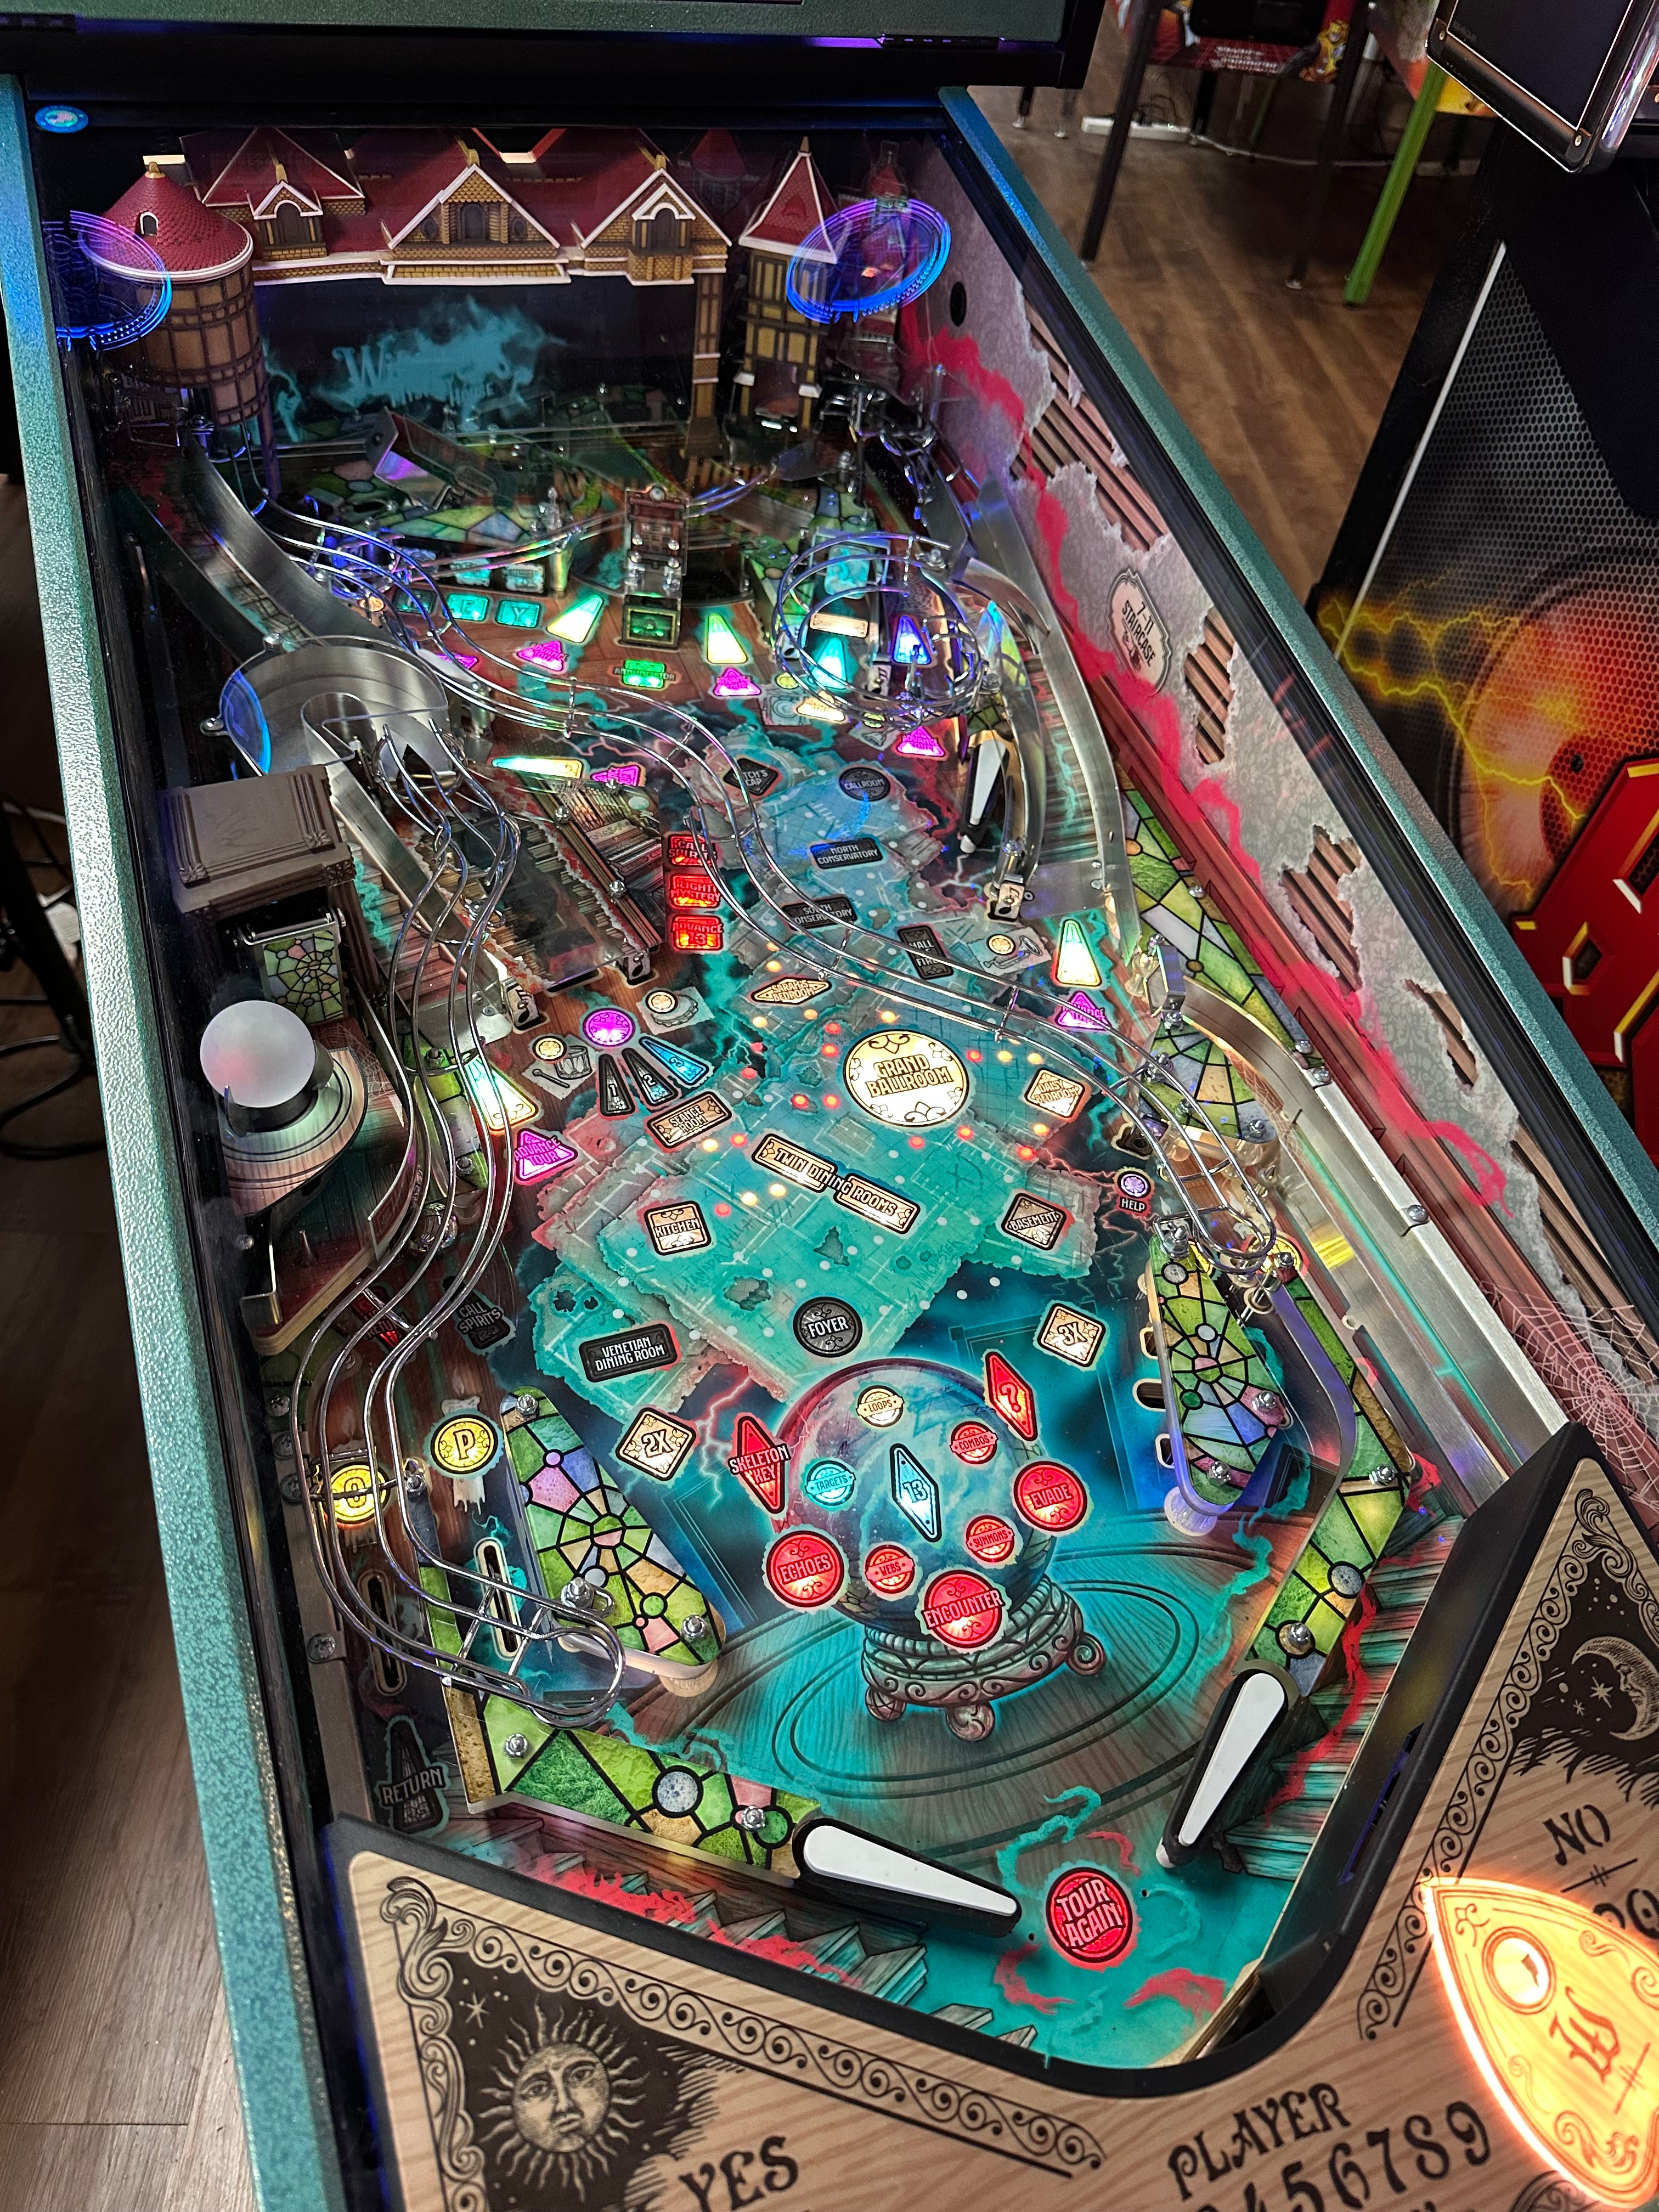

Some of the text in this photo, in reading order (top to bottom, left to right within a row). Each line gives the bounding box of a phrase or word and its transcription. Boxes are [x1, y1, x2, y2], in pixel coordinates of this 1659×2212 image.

[512, 607, 528, 619] Y
[1122, 600, 1155, 667] STAIRCASE
[531, 643, 568, 661] ADVANCE
[614, 667, 675, 680] ANNUNCIATOR
[902, 734, 938, 747] ADVANCE
[745, 778, 763, 787] CAP
[844, 778, 884, 791] CALLROOM
[817, 848, 878, 865] CONSERVATORY
[830, 844, 859, 854] NORTH
[671, 889, 721, 902] MYSTERY
[672, 922, 724, 933] ADVANCE
[771, 979, 809, 992] SARAH'S
[773, 988, 816, 1003] BEDROOM
[670, 1057, 684, 1068] 3
[873, 1054, 930, 1077] GRAND
[609, 1084, 618, 1097] 1
[643, 1074, 656, 1087] 2
[865, 1066, 954, 1098] BALLROOM
[1039, 1080, 1064, 1093] DAISY
[1035, 1087, 1080, 1104] BEDROOM
[669, 1104, 704, 1128] SEANCE
[680, 1115, 707, 1134] ROOM
[514, 1136, 560, 1161] ADVANCE
[528, 1149, 559, 1167] TOUR
[774, 1147, 898, 1216] TWIN DINING ROOMS
[1121, 1198, 1146, 1212] HELP
[655, 1217, 700, 1238] KITCHEN
[1010, 1210, 1057, 1231] BASEMENT
[459, 1301, 488, 1317] CALL
[459, 1308, 502, 1334] SPIRITS
[808, 1316, 850, 1339] FOYER
[1057, 1321, 1088, 1346] 3X
[602, 1336, 652, 1358] VENETIAN
[595, 1345, 665, 1372] DINING ROOM
[867, 1400, 893, 1413] LOOPS
[1000, 1382, 1023, 1413] ?
[454, 1429, 476, 1460] P
[641, 1429, 675, 1458] 2X
[958, 1434, 989, 1451] COMBOS
[729, 1444, 790, 1474] SKELETON
[754, 1464, 776, 1484] KEY
[815, 1474, 848, 1491] TARGETS
[902, 1479, 928, 1503] 13
[1029, 1483, 1073, 1509] EVADE
[973, 1529, 1008, 1548] SUMMONS
[780, 1554, 832, 1584] ECHOES
[879, 1561, 901, 1576] WEBS
[923, 1590, 1004, 1629] ENCOUNTER
[381, 1767, 445, 1804] RETURN
[1543, 1803, 1611, 1865] NO
[1056, 1878, 1111, 1921] TOUR
[1065, 1902, 1123, 1947] AGAIN
[1168, 2083, 1351, 2202] PLAYER
[678, 2136, 799, 2212] YES
